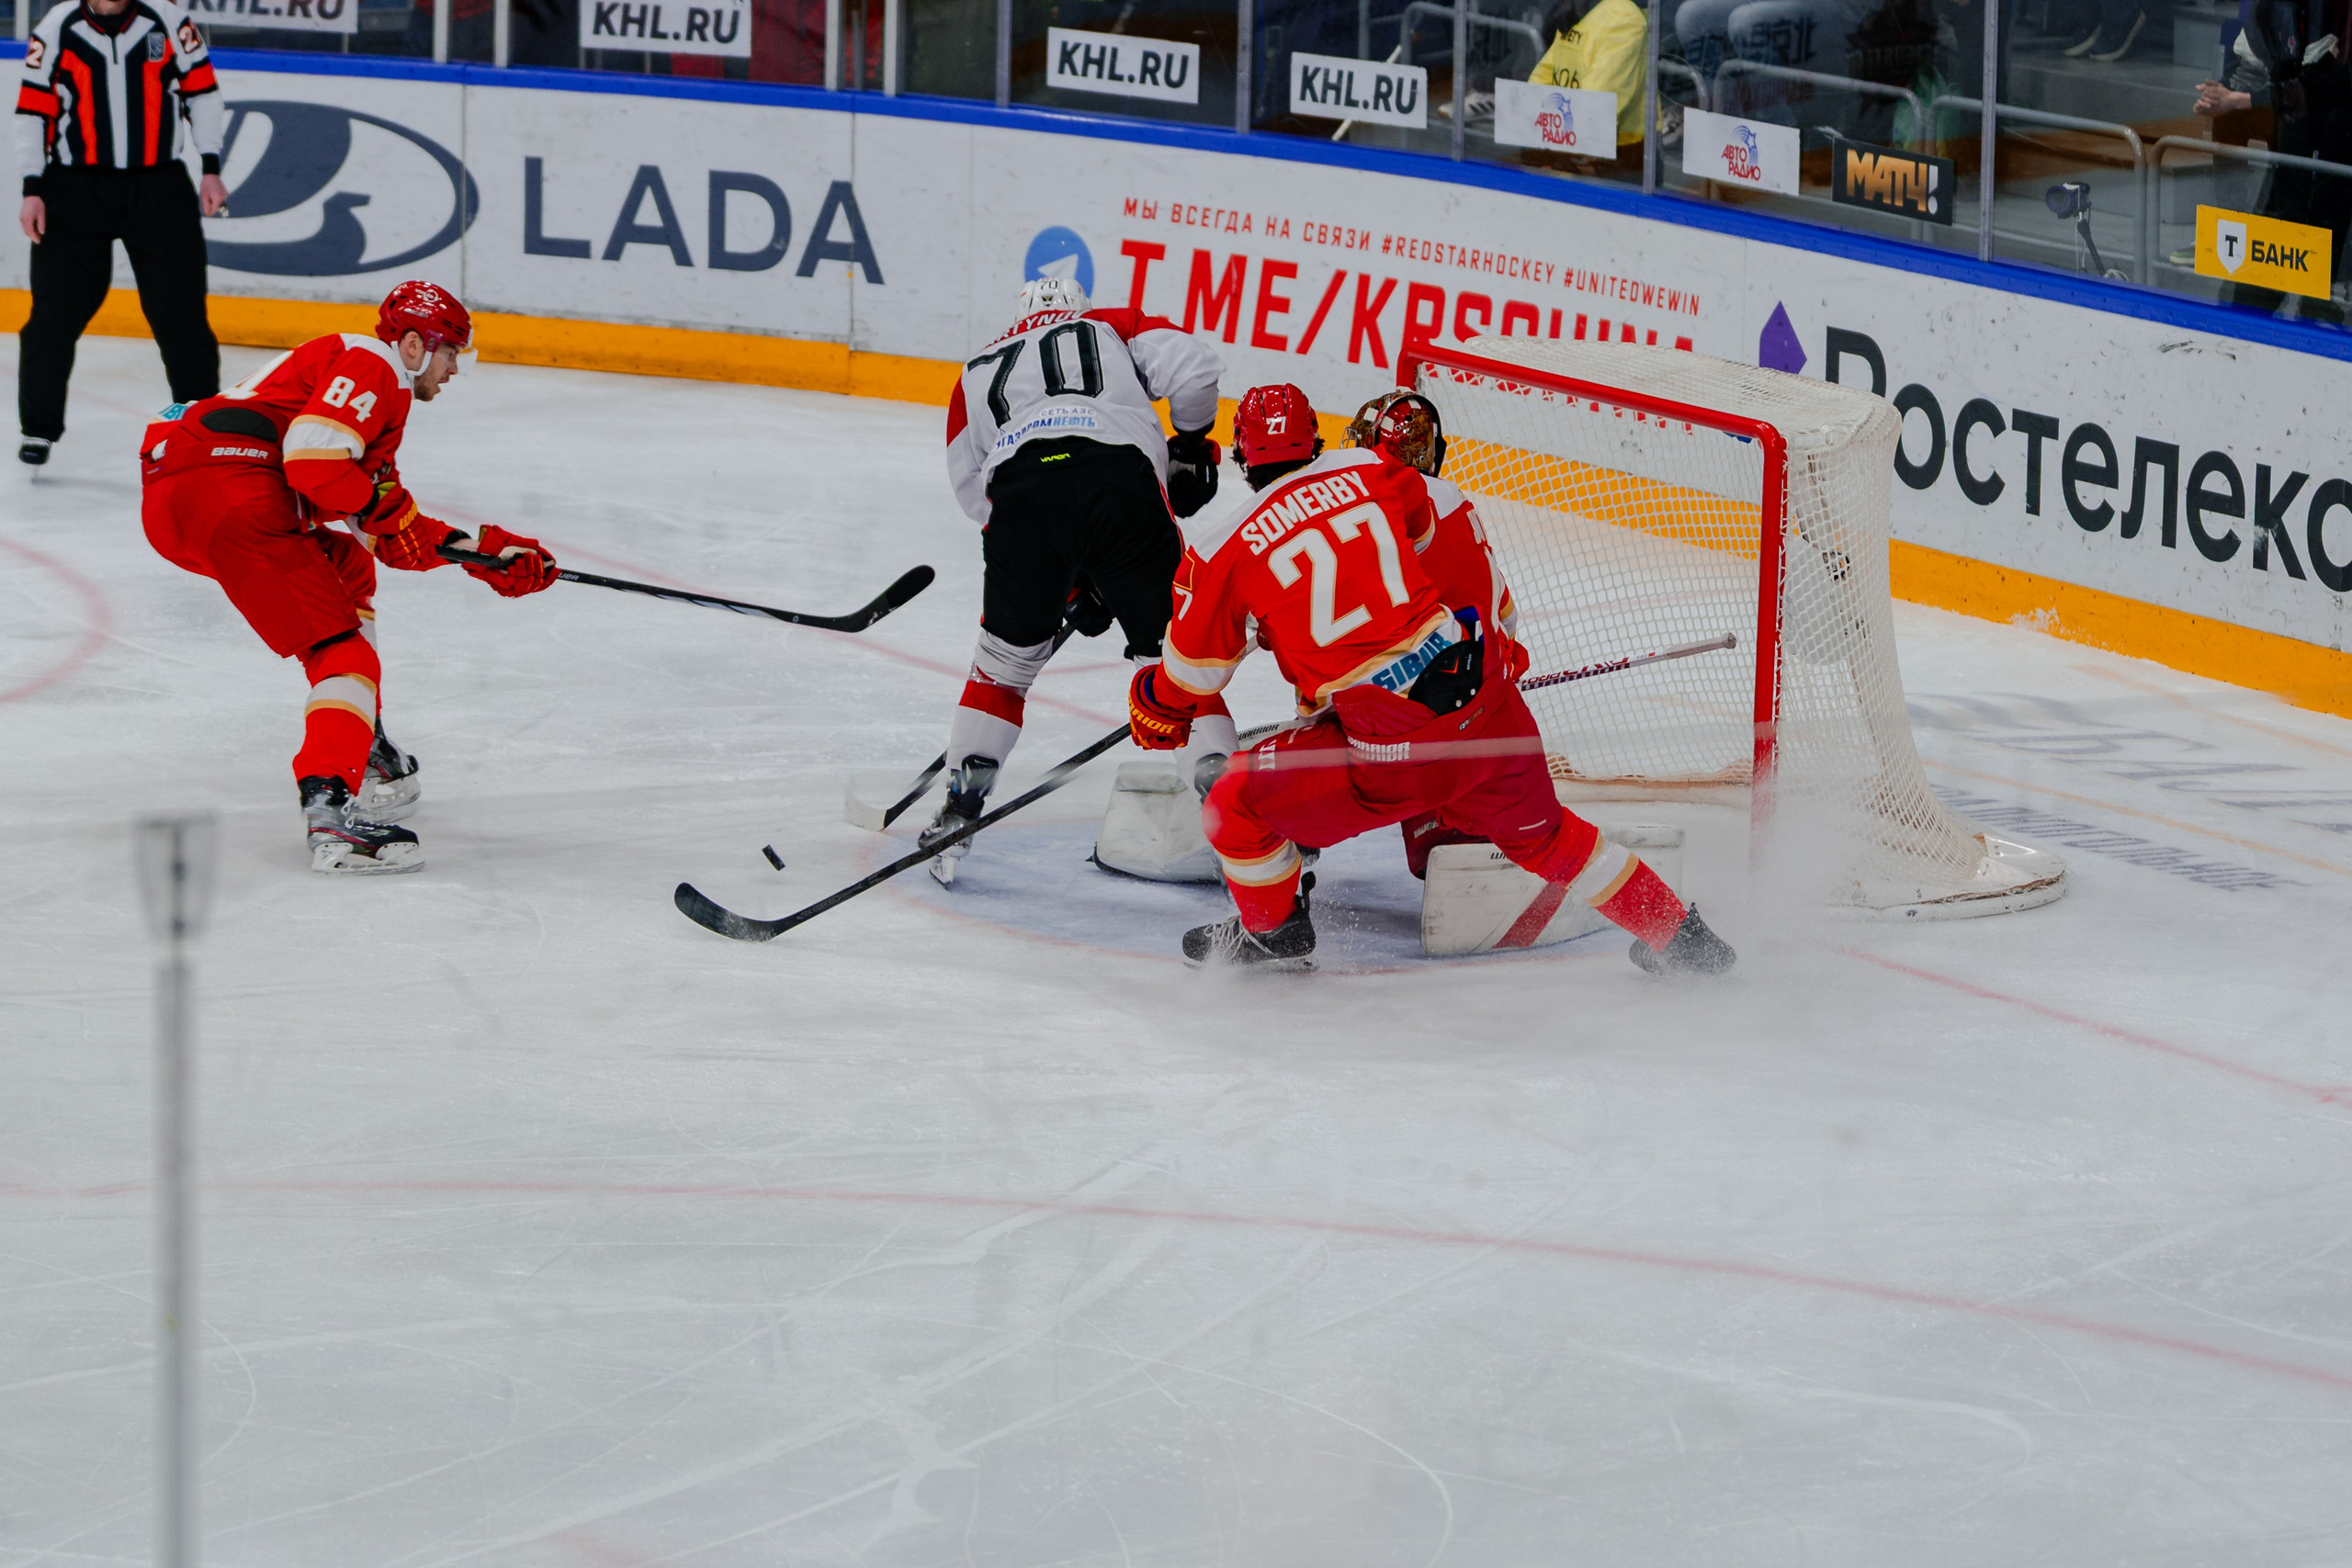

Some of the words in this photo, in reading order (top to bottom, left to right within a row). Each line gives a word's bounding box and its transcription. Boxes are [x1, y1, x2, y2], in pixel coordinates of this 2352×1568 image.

[593, 2, 740, 43] KHL.RU
[1057, 40, 1189, 89] KHL.RU
[1299, 64, 1418, 115] KHL.RU
[1534, 112, 1562, 129] АВТО
[1542, 127, 1577, 146] РАДИО
[1721, 144, 1747, 161] АВТО
[1727, 161, 1761, 181] РАДИО
[1847, 148, 1939, 215] МАТЧ!
[524, 155, 886, 285] LADA
[1124, 197, 1158, 220] МЫ
[1170, 203, 1252, 234] ВСЕГДА
[1265, 216, 1290, 239] НА
[1303, 221, 1371, 251] СВЯЗИ
[1381, 233, 1555, 285] #REDSTARHOCKEY
[1564, 266, 1700, 316] #UNITEDWEWIN
[2251, 240, 2309, 272] БАНК
[967, 320, 1103, 429] 70
[322, 376, 378, 423] 84
[1041, 408, 1069, 417] СЕТЬ
[1071, 407, 1095, 415] АЗС
[1266, 416, 1286, 434] 27
[1240, 471, 1370, 557] SOMERBY
[1267, 501, 1410, 648] 27
[1347, 736, 1410, 754] WARRIOR
